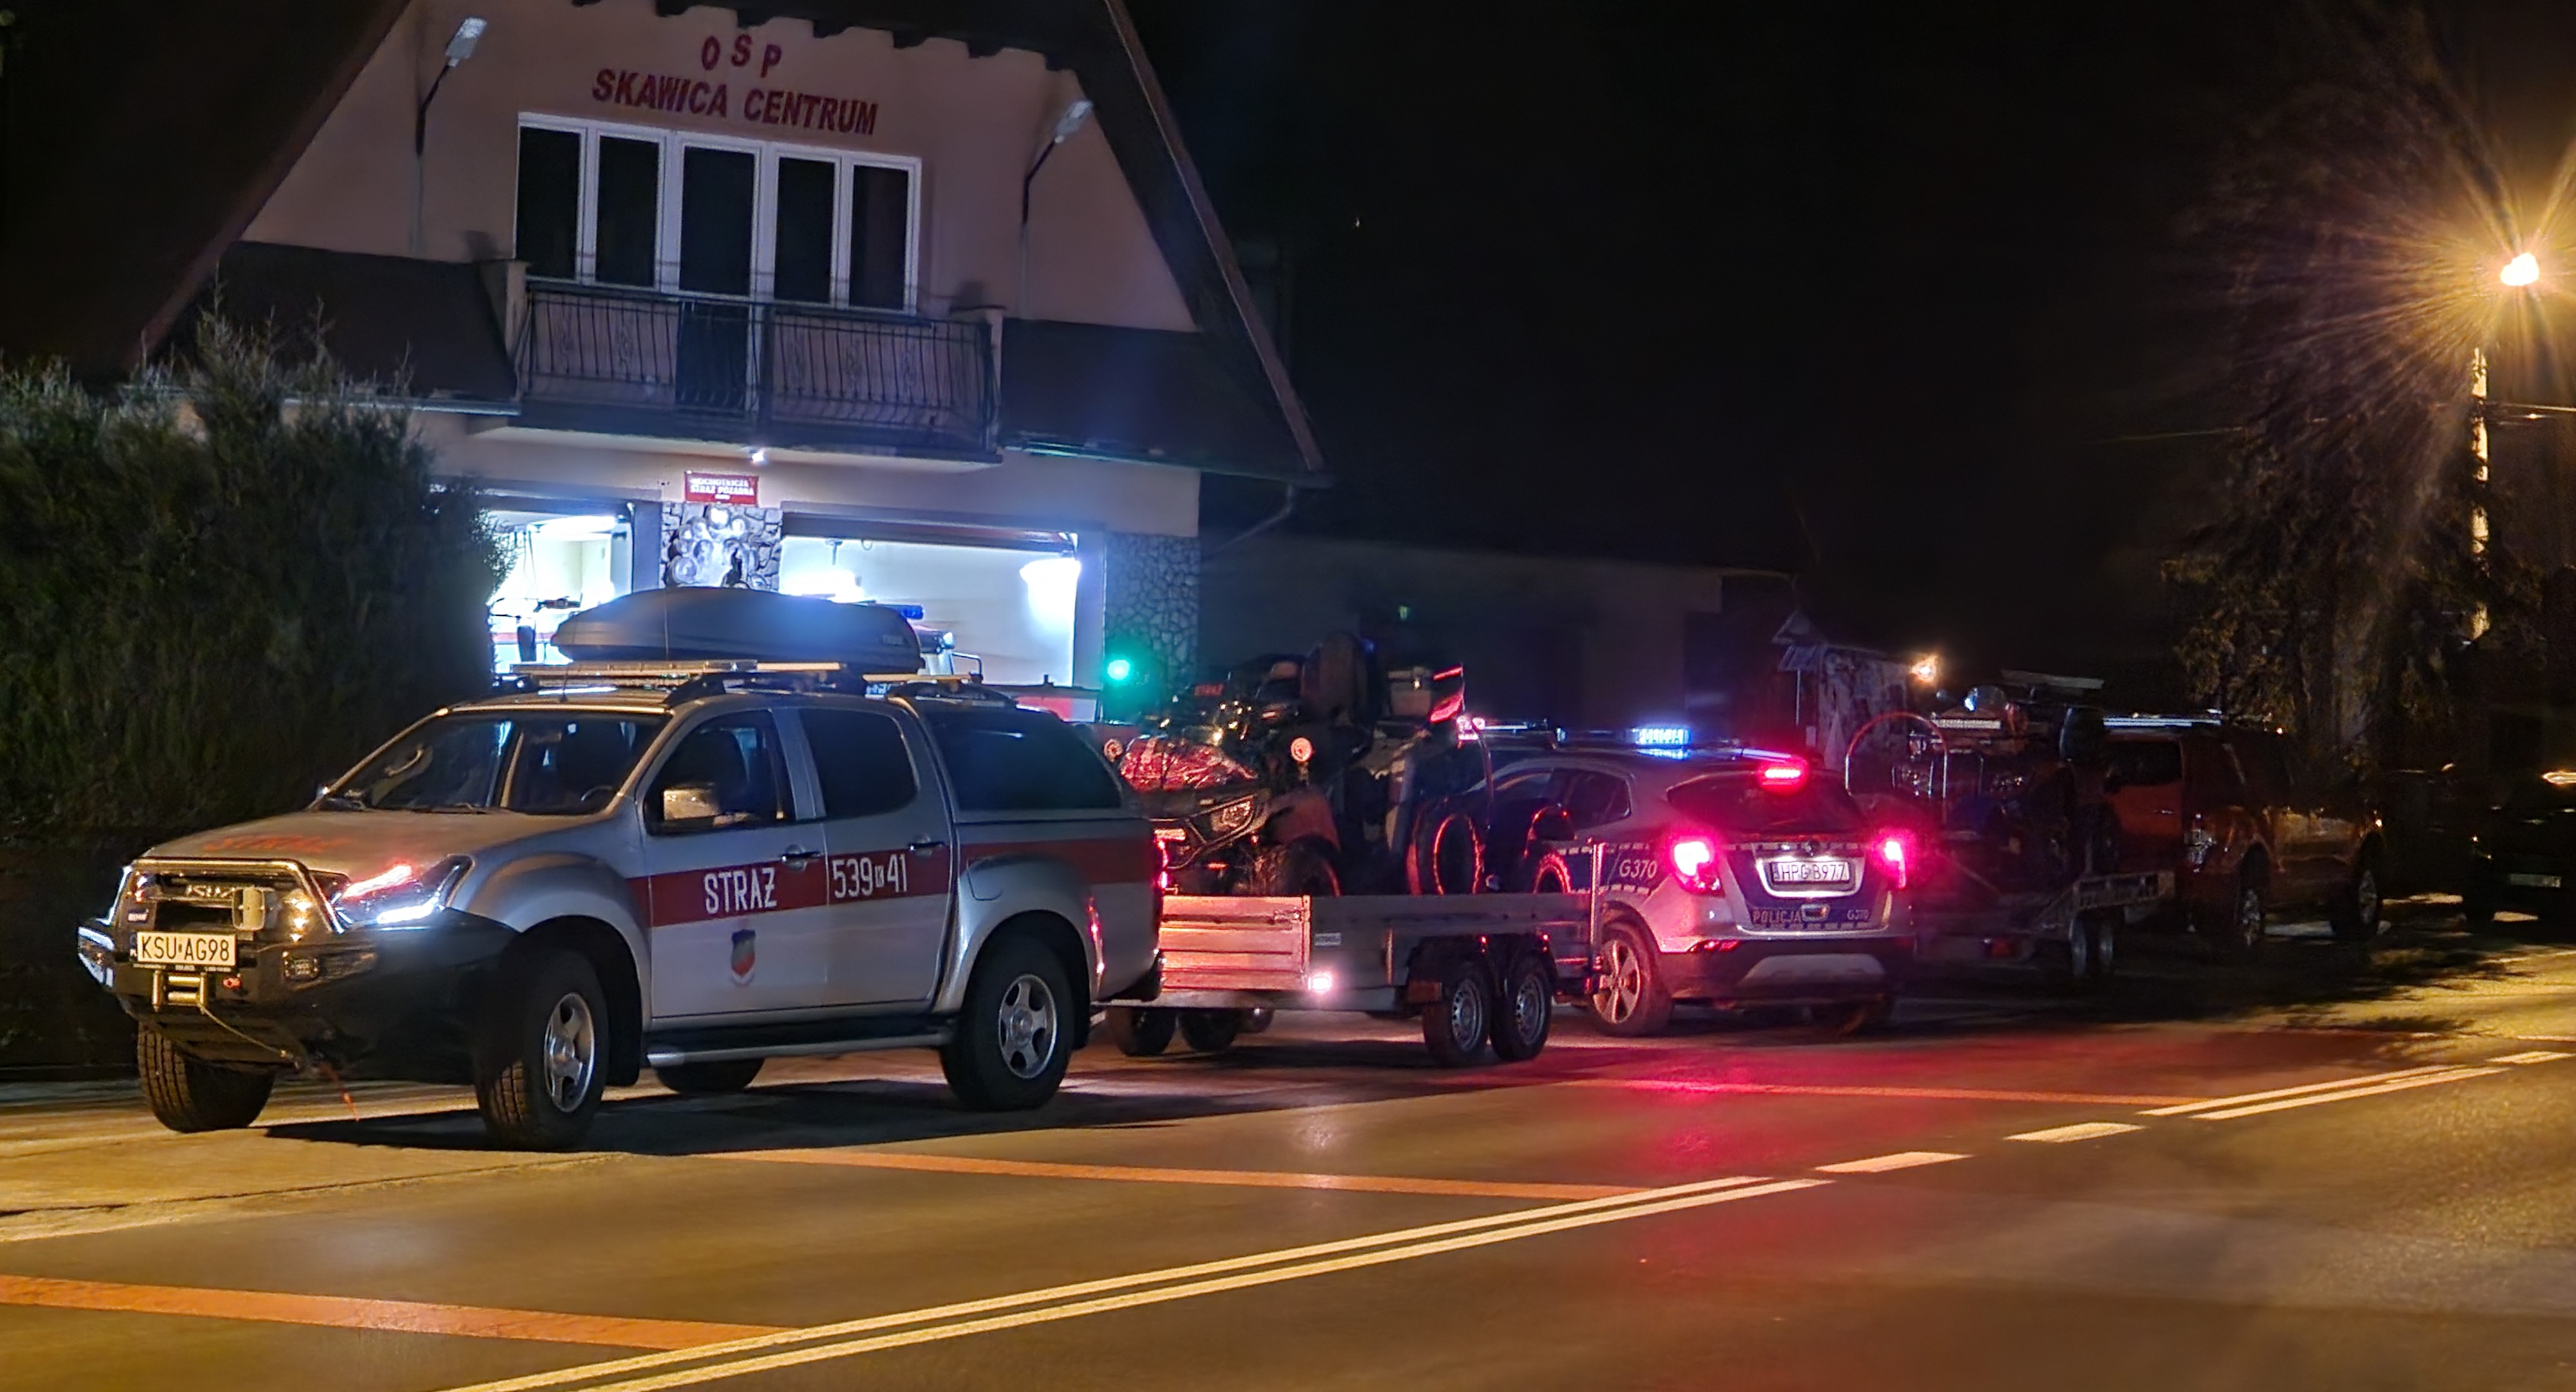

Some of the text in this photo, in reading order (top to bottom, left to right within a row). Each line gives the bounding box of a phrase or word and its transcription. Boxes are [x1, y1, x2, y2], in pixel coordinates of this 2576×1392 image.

[592, 68, 879, 135] SKAWICA CENTRUM
[1619, 859, 1658, 879] G370
[1781, 864, 1811, 880] HPG
[1752, 908, 1802, 924] POLICJA
[141, 936, 230, 962] KSU AG98
